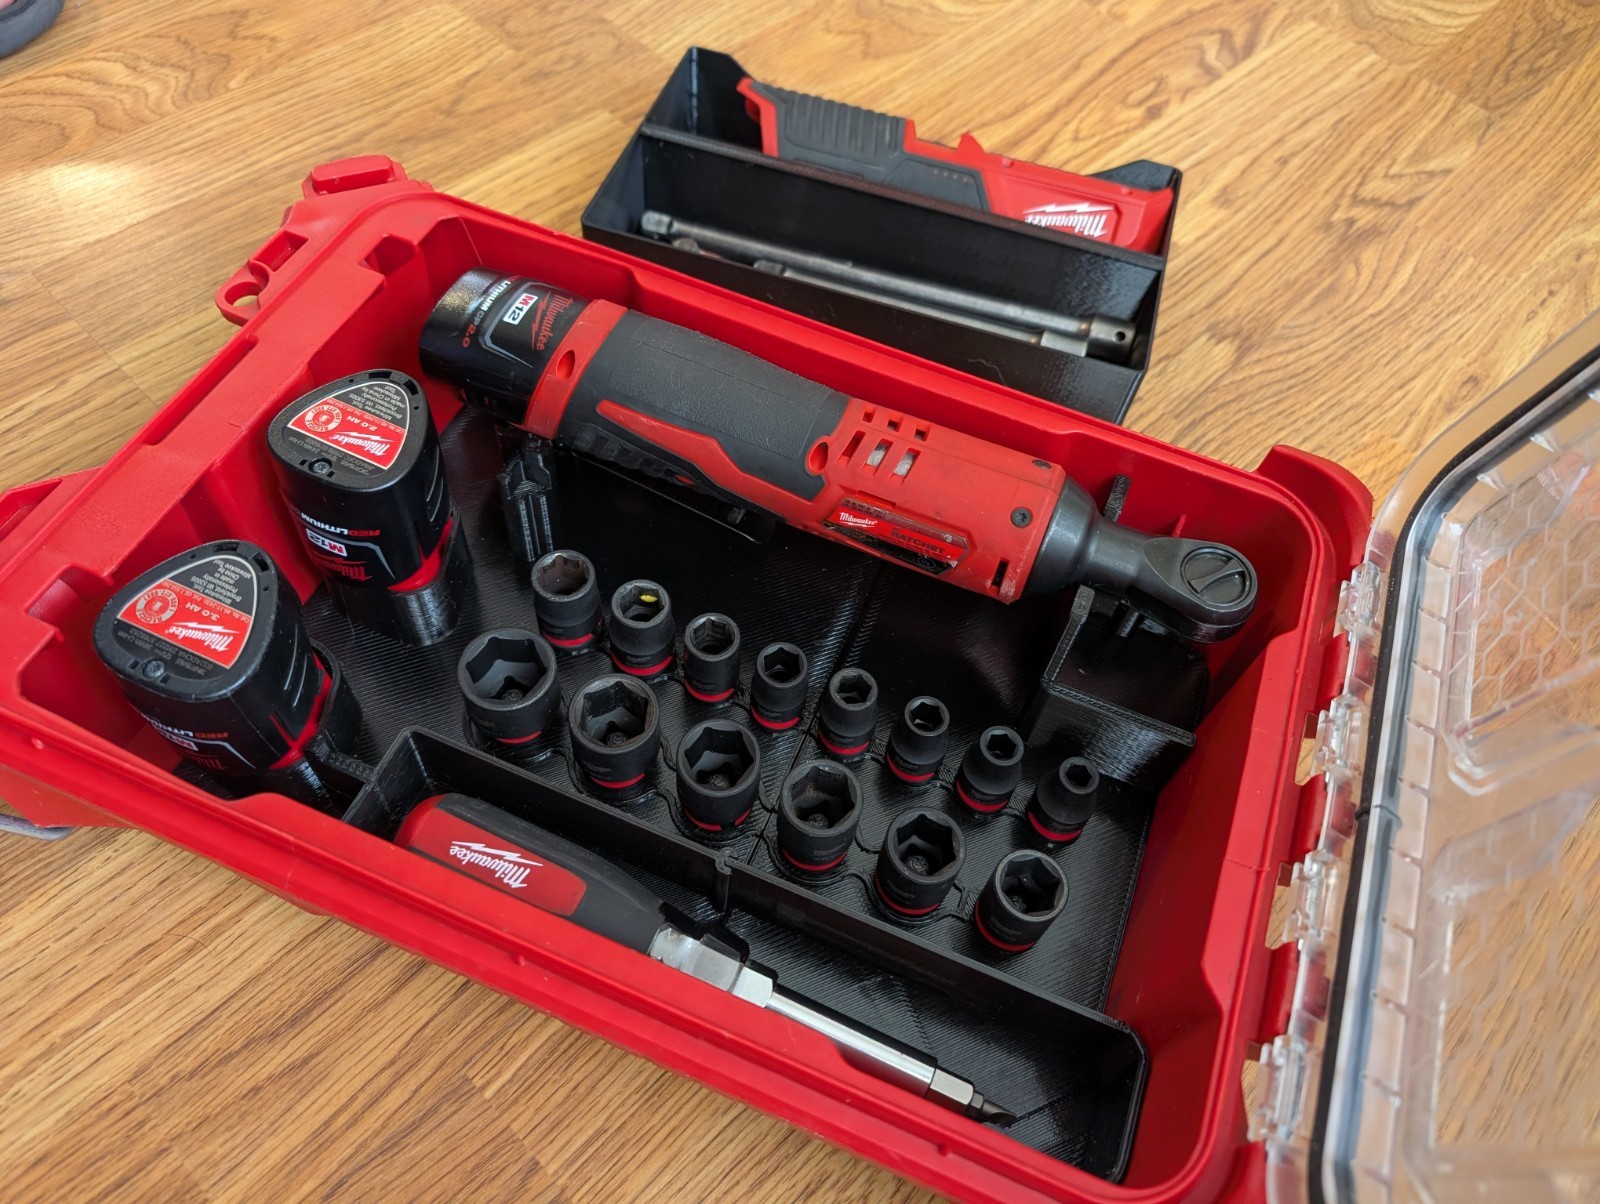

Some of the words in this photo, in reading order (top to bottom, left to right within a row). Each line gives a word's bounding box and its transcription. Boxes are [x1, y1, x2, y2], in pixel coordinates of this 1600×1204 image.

[508, 294, 535, 322] M12
[537, 293, 574, 351] Milwaukee
[369, 390, 384, 399] China
[373, 386, 401, 401] Milwaukee
[362, 392, 397, 411] Professionally
[390, 399, 406, 408] made
[346, 415, 361, 424] AH
[365, 406, 392, 420] Milwaukee
[361, 421, 378, 432] 2.0
[333, 434, 390, 458] Milwaukee
[300, 512, 382, 537] REDLITHIUM
[839, 511, 876, 526] Milwaukee
[309, 532, 345, 555] M12
[891, 530, 945, 554] RATCHET
[217, 566, 226, 574] by
[224, 563, 252, 579] Milwaukee
[224, 570, 240, 580] China
[202, 573, 239, 594] Professionally
[219, 574, 235, 585] made
[204, 588, 232, 605] Milwaukee
[185, 601, 202, 613] AH
[202, 609, 220, 621] 3.0
[169, 625, 234, 653] Milwaukee
[449, 845, 531, 888] Milwaukee
